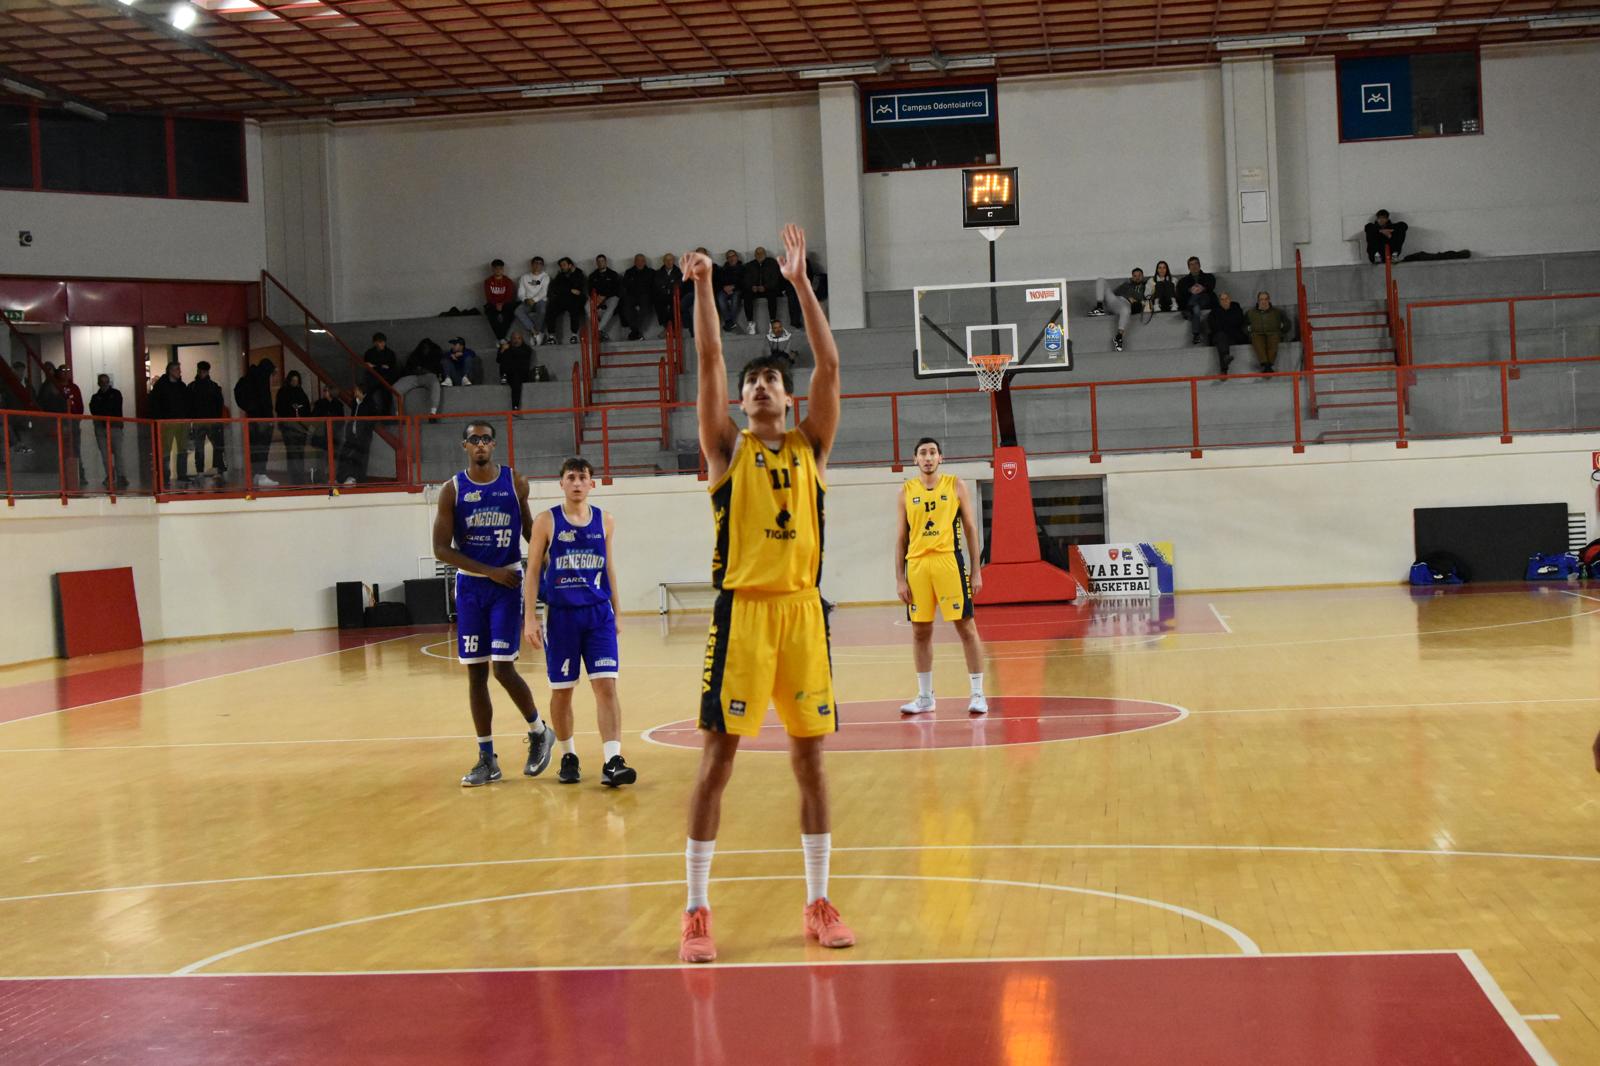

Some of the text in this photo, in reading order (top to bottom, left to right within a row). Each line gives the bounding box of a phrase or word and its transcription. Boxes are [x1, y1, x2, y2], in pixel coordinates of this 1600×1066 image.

[901, 100, 983, 112] Campus Odontoiatrico
[769, 468, 791, 490] 11
[555, 553, 605, 570] VENEGONO
[593, 571, 603, 590] 4
[560, 658, 571, 677] 4
